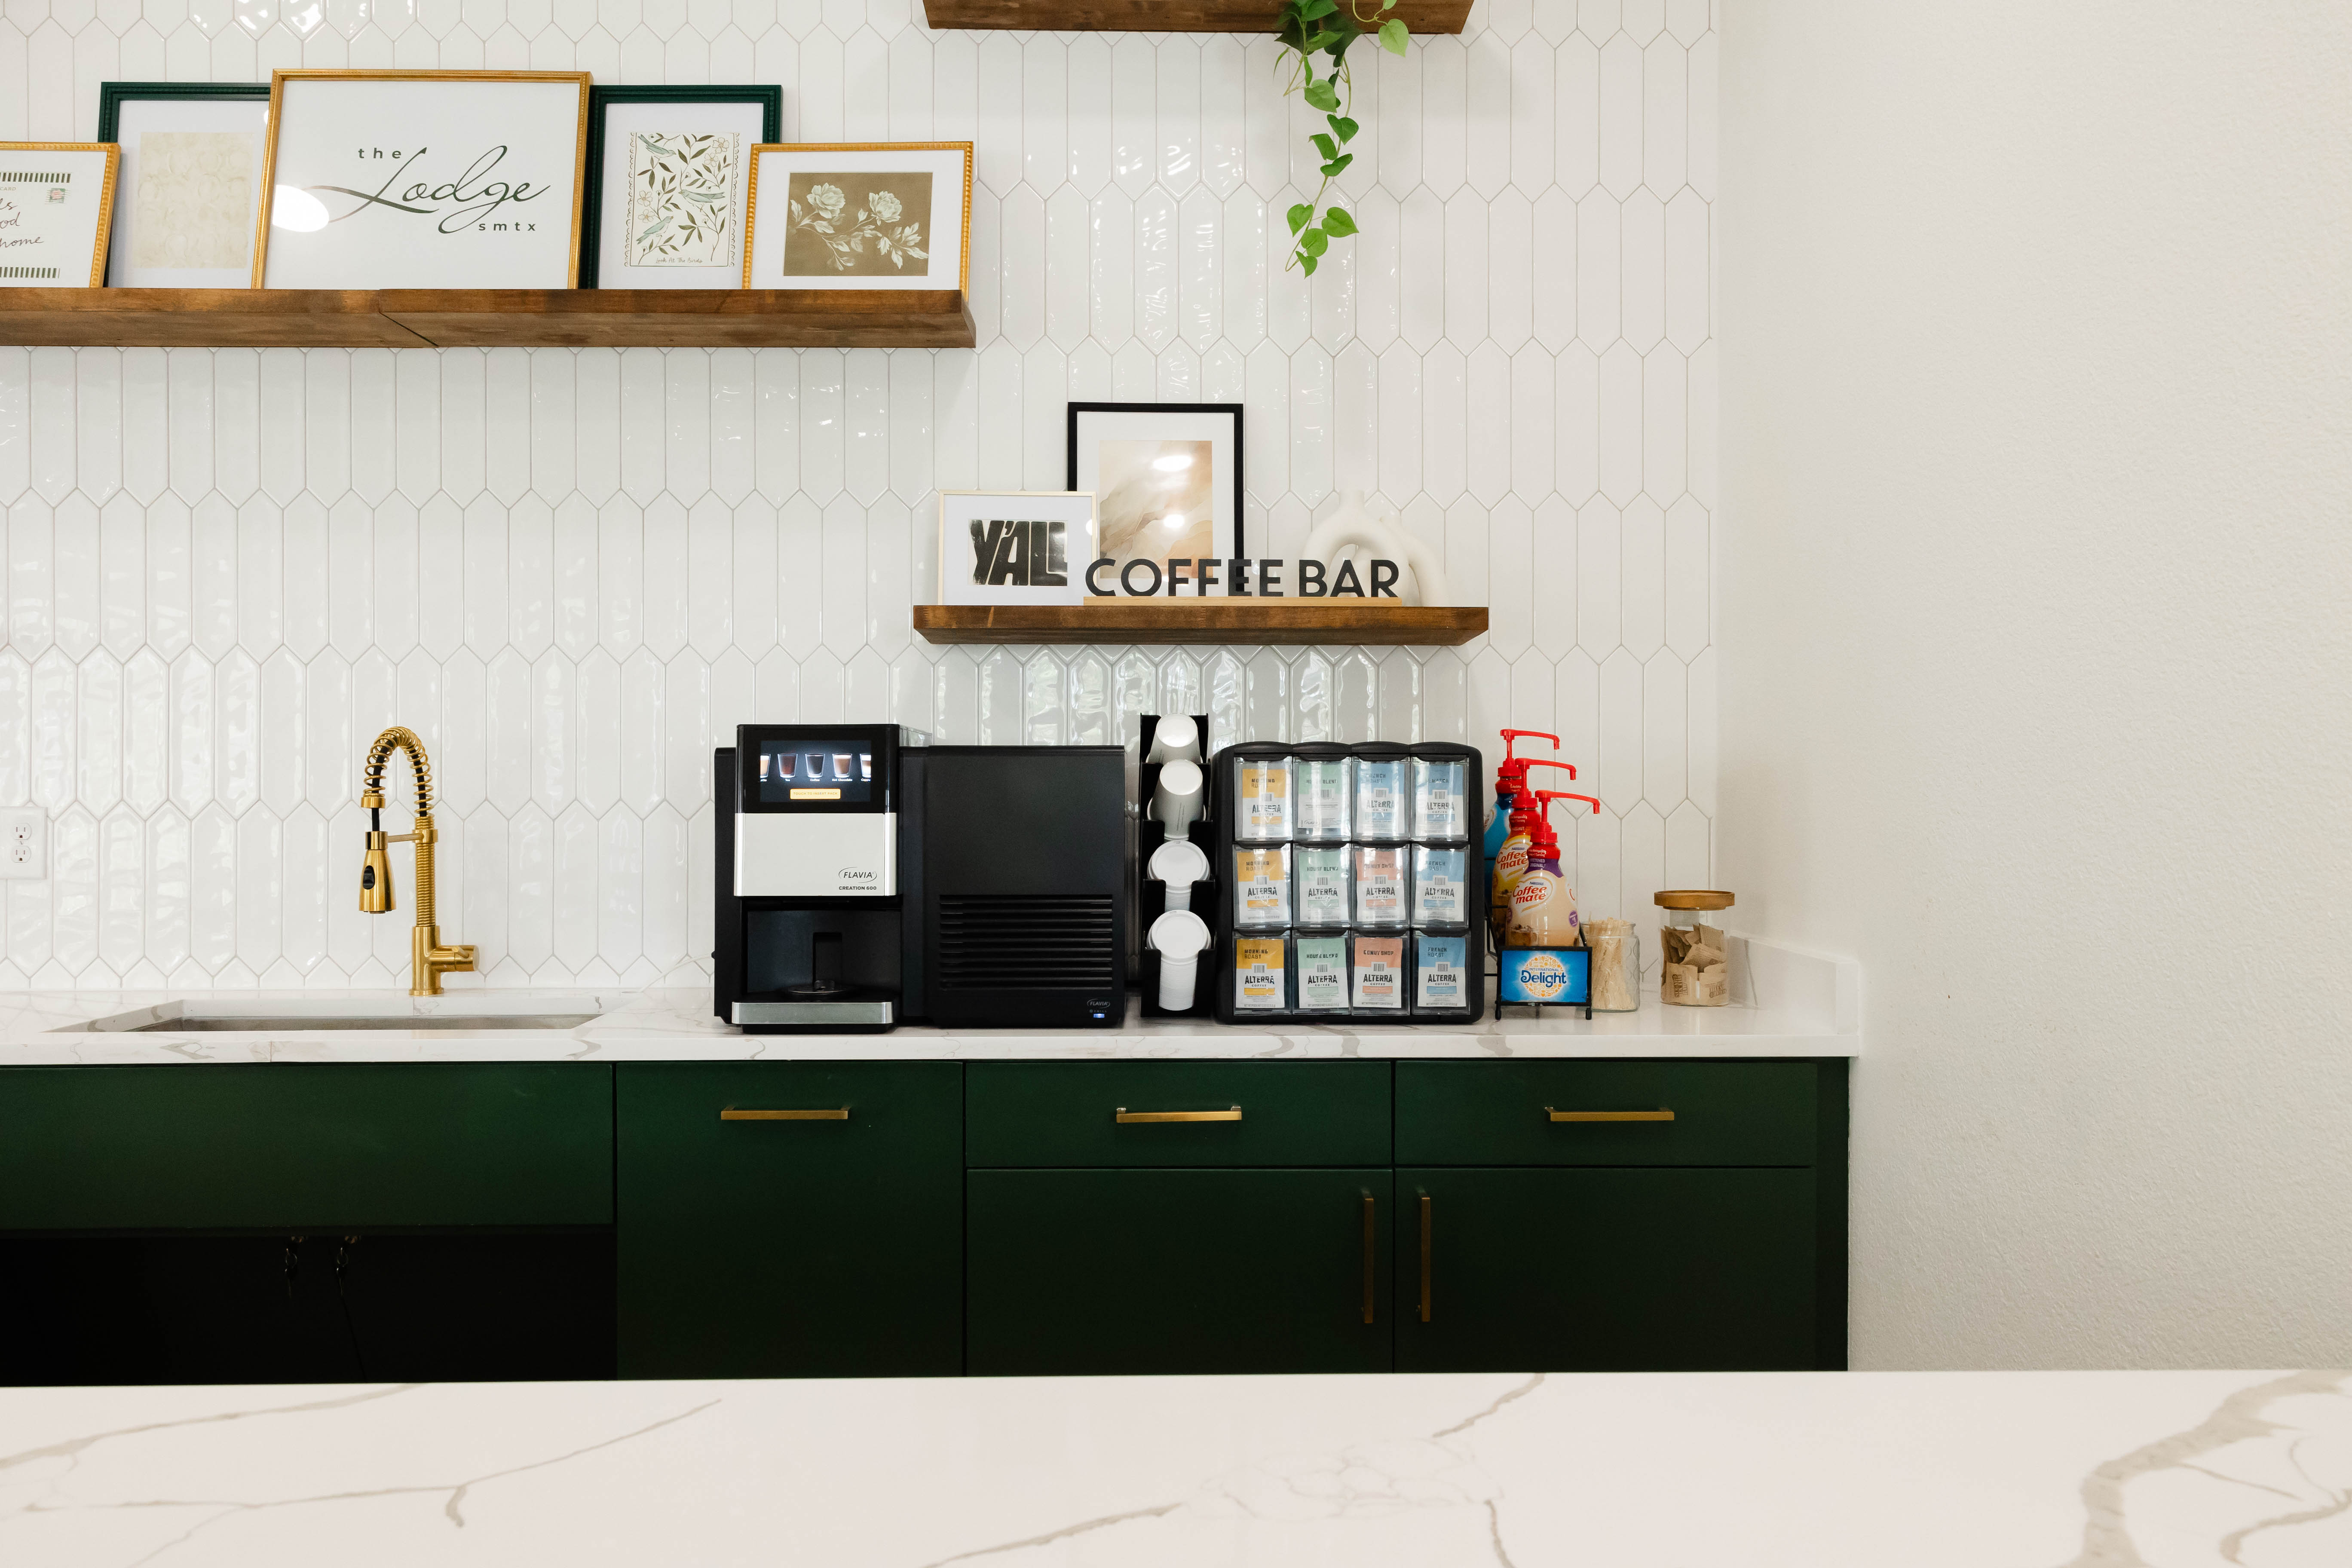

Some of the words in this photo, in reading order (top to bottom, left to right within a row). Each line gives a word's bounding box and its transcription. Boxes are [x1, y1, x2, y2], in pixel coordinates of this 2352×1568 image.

[358, 147, 402, 159] the
[302, 145, 551, 234] Lodge
[478, 222, 536, 231] smtx
[969, 520, 1068, 586] Y'ALL
[1085, 558, 1283, 597] COFFEE
[1299, 559, 1399, 597] BAR
[1497, 851, 1527, 864] Coffee
[1500, 858, 1528, 870] mate
[1247, 887, 1277, 897] ALTERRA
[1308, 888, 1338, 897] ALTERRA
[1366, 887, 1395, 897] ALTERRA
[1513, 885, 1547, 897] Coffee
[1516, 893, 1547, 904] mate
[1245, 975, 1274, 985] ALTERRA
[1308, 974, 1338, 984] ALTERRA
[1363, 974, 1393, 983] ALTERRA
[1427, 974, 1456, 983] ALTERRA
[1520, 970, 1567, 987] Delight
